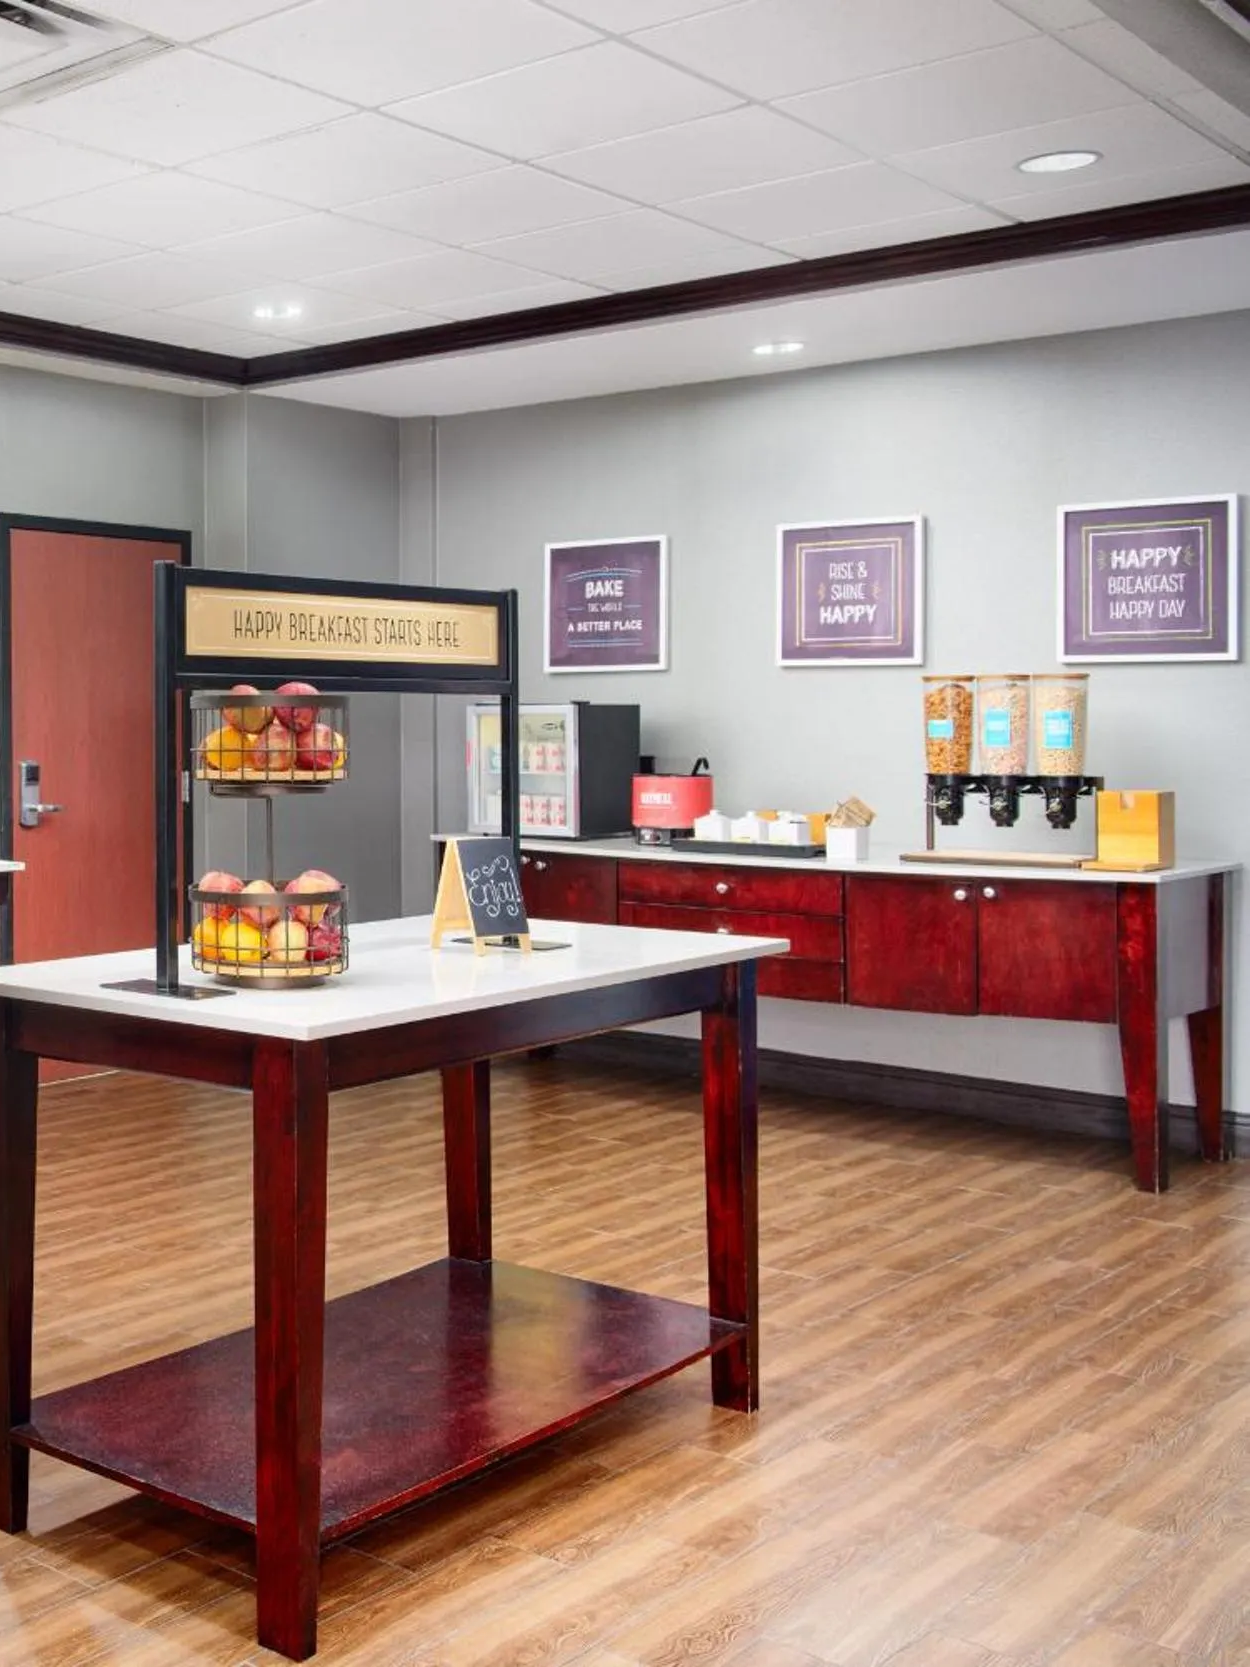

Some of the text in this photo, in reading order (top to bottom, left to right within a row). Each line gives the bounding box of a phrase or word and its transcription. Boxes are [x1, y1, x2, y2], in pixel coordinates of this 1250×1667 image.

[1110, 546, 1182, 570] HAPPY
[829, 561, 868, 580] RISE &
[585, 579, 625, 599] BAKE
[831, 583, 866, 601] SHINE
[1107, 573, 1186, 595] BREAKFAST
[819, 604, 877, 625] HAPPY
[1109, 599, 1186, 620] HAPPY DAY
[233, 609, 461, 648] HAPPY BREAKFAST STARTS HERE
[567, 619, 643, 633] A BETTER PLACE
